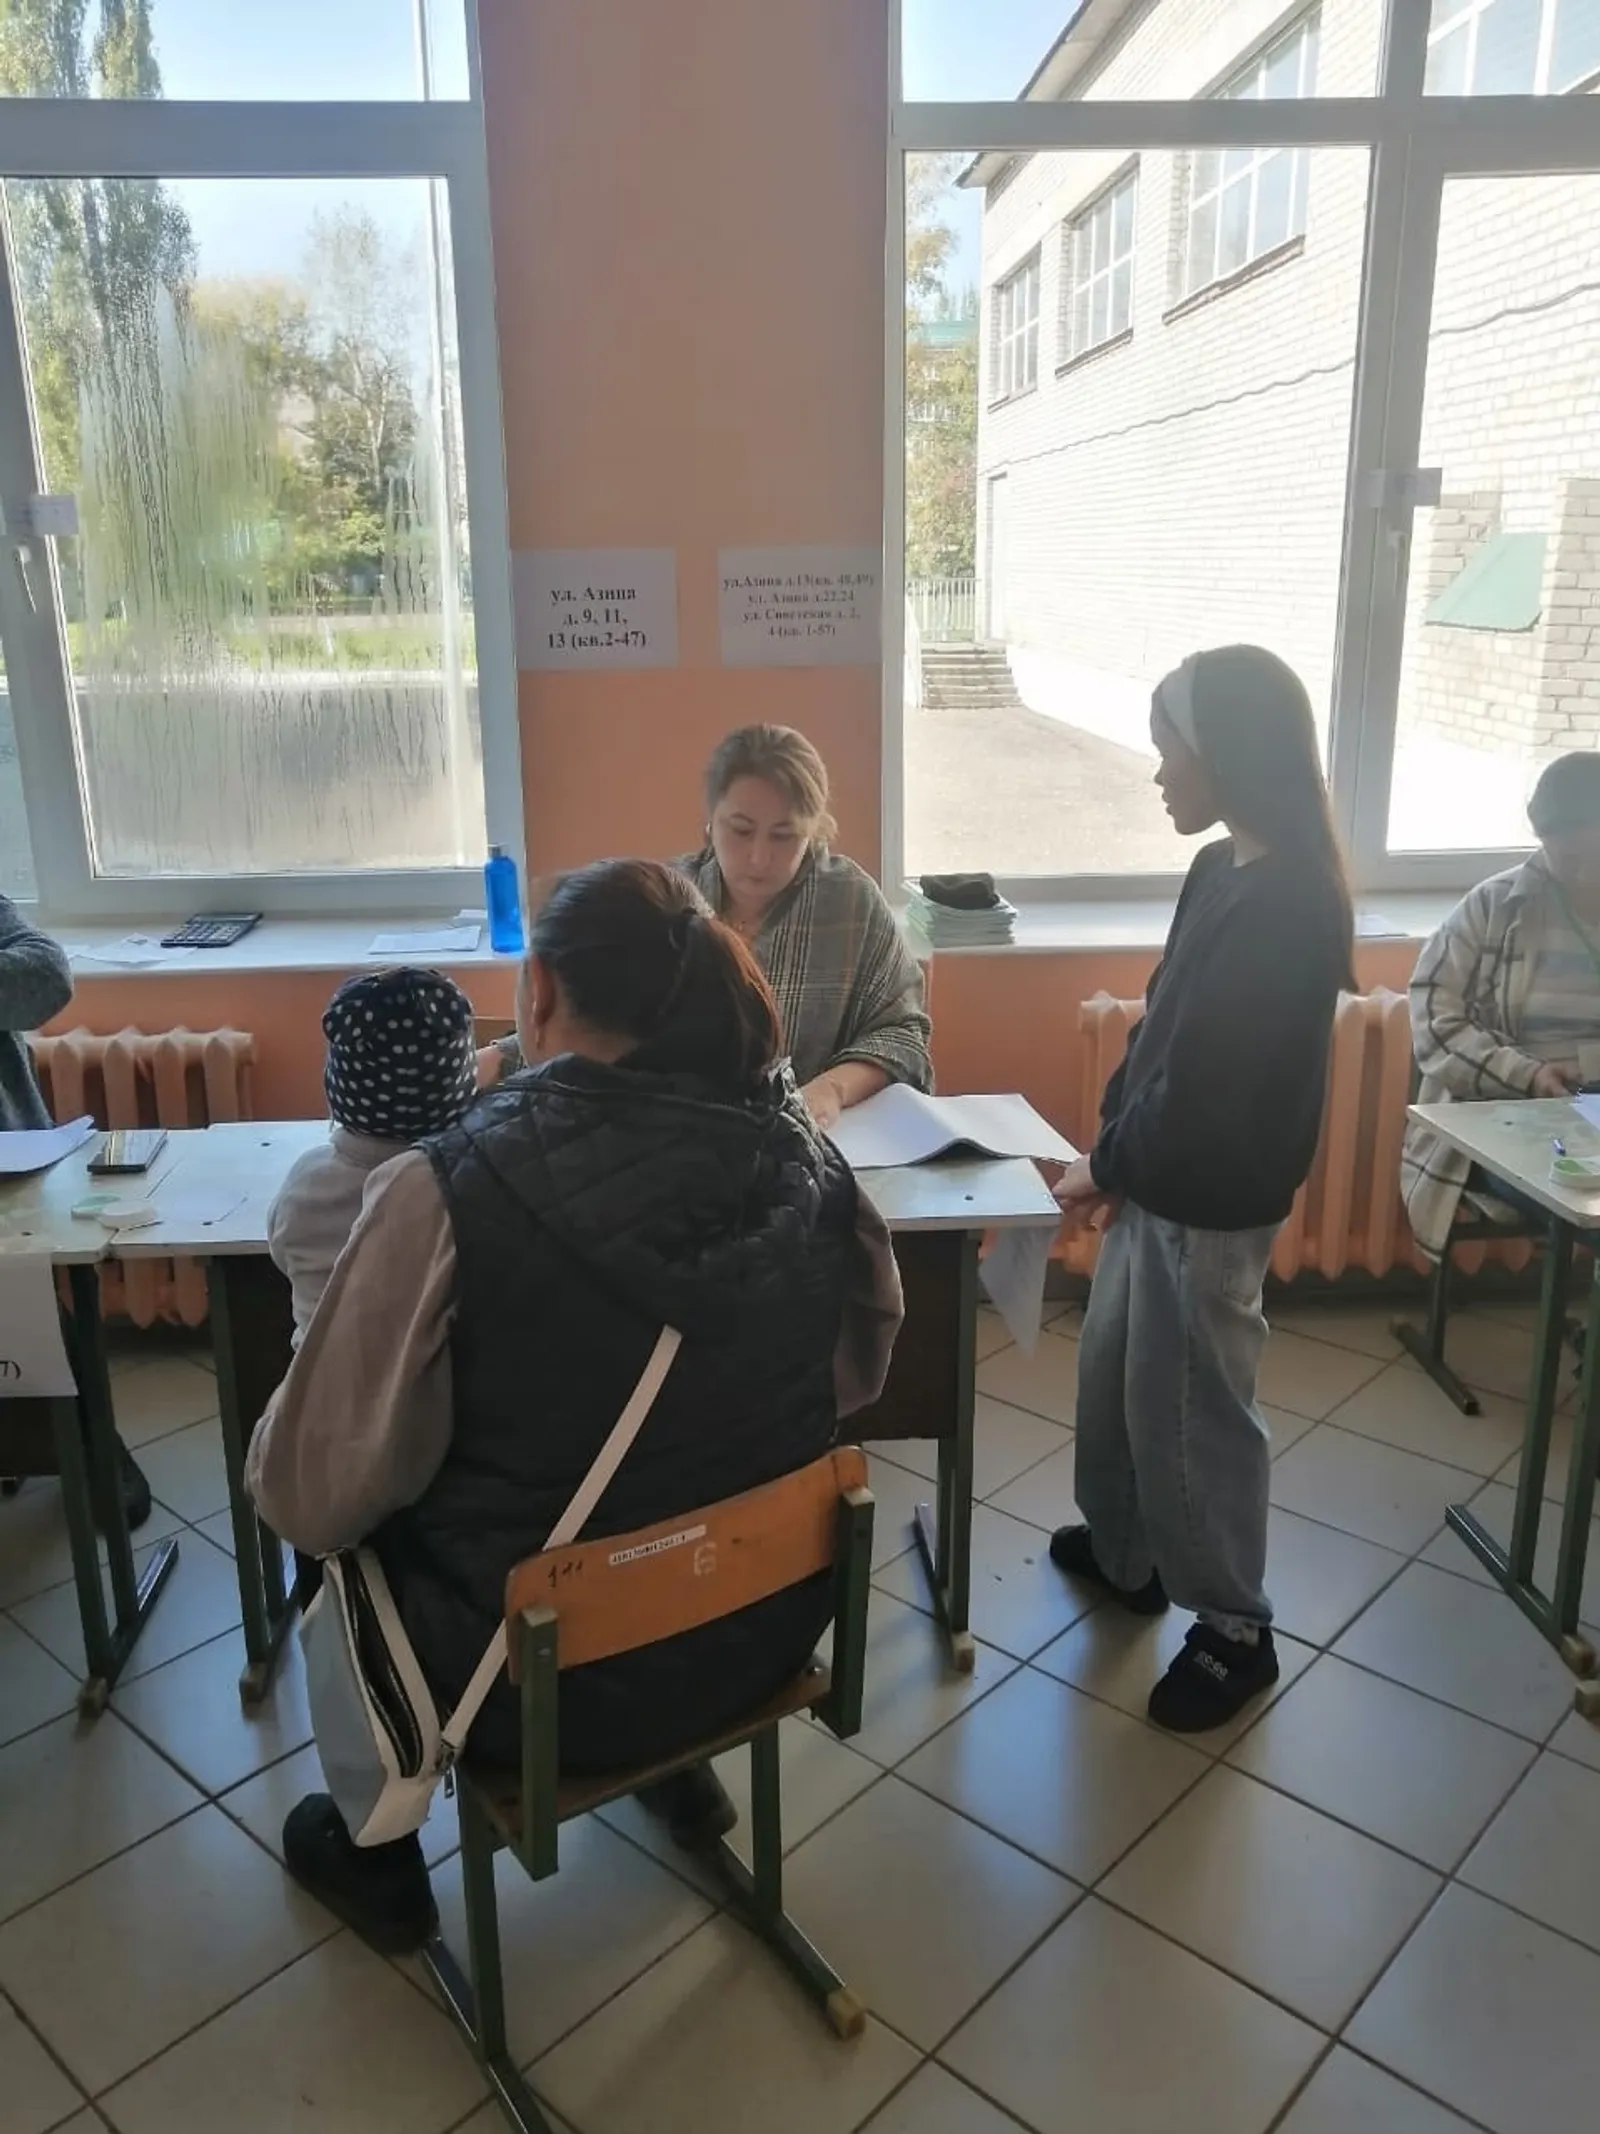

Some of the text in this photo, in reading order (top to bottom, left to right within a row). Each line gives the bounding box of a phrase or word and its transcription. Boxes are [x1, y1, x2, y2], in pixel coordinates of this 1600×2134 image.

[550, 587, 637, 606] ул. Азина
[583, 608, 599, 625] 9,
[605, 608, 628, 624] 11,
[548, 630, 647, 651] 13 (кв.2-47)
